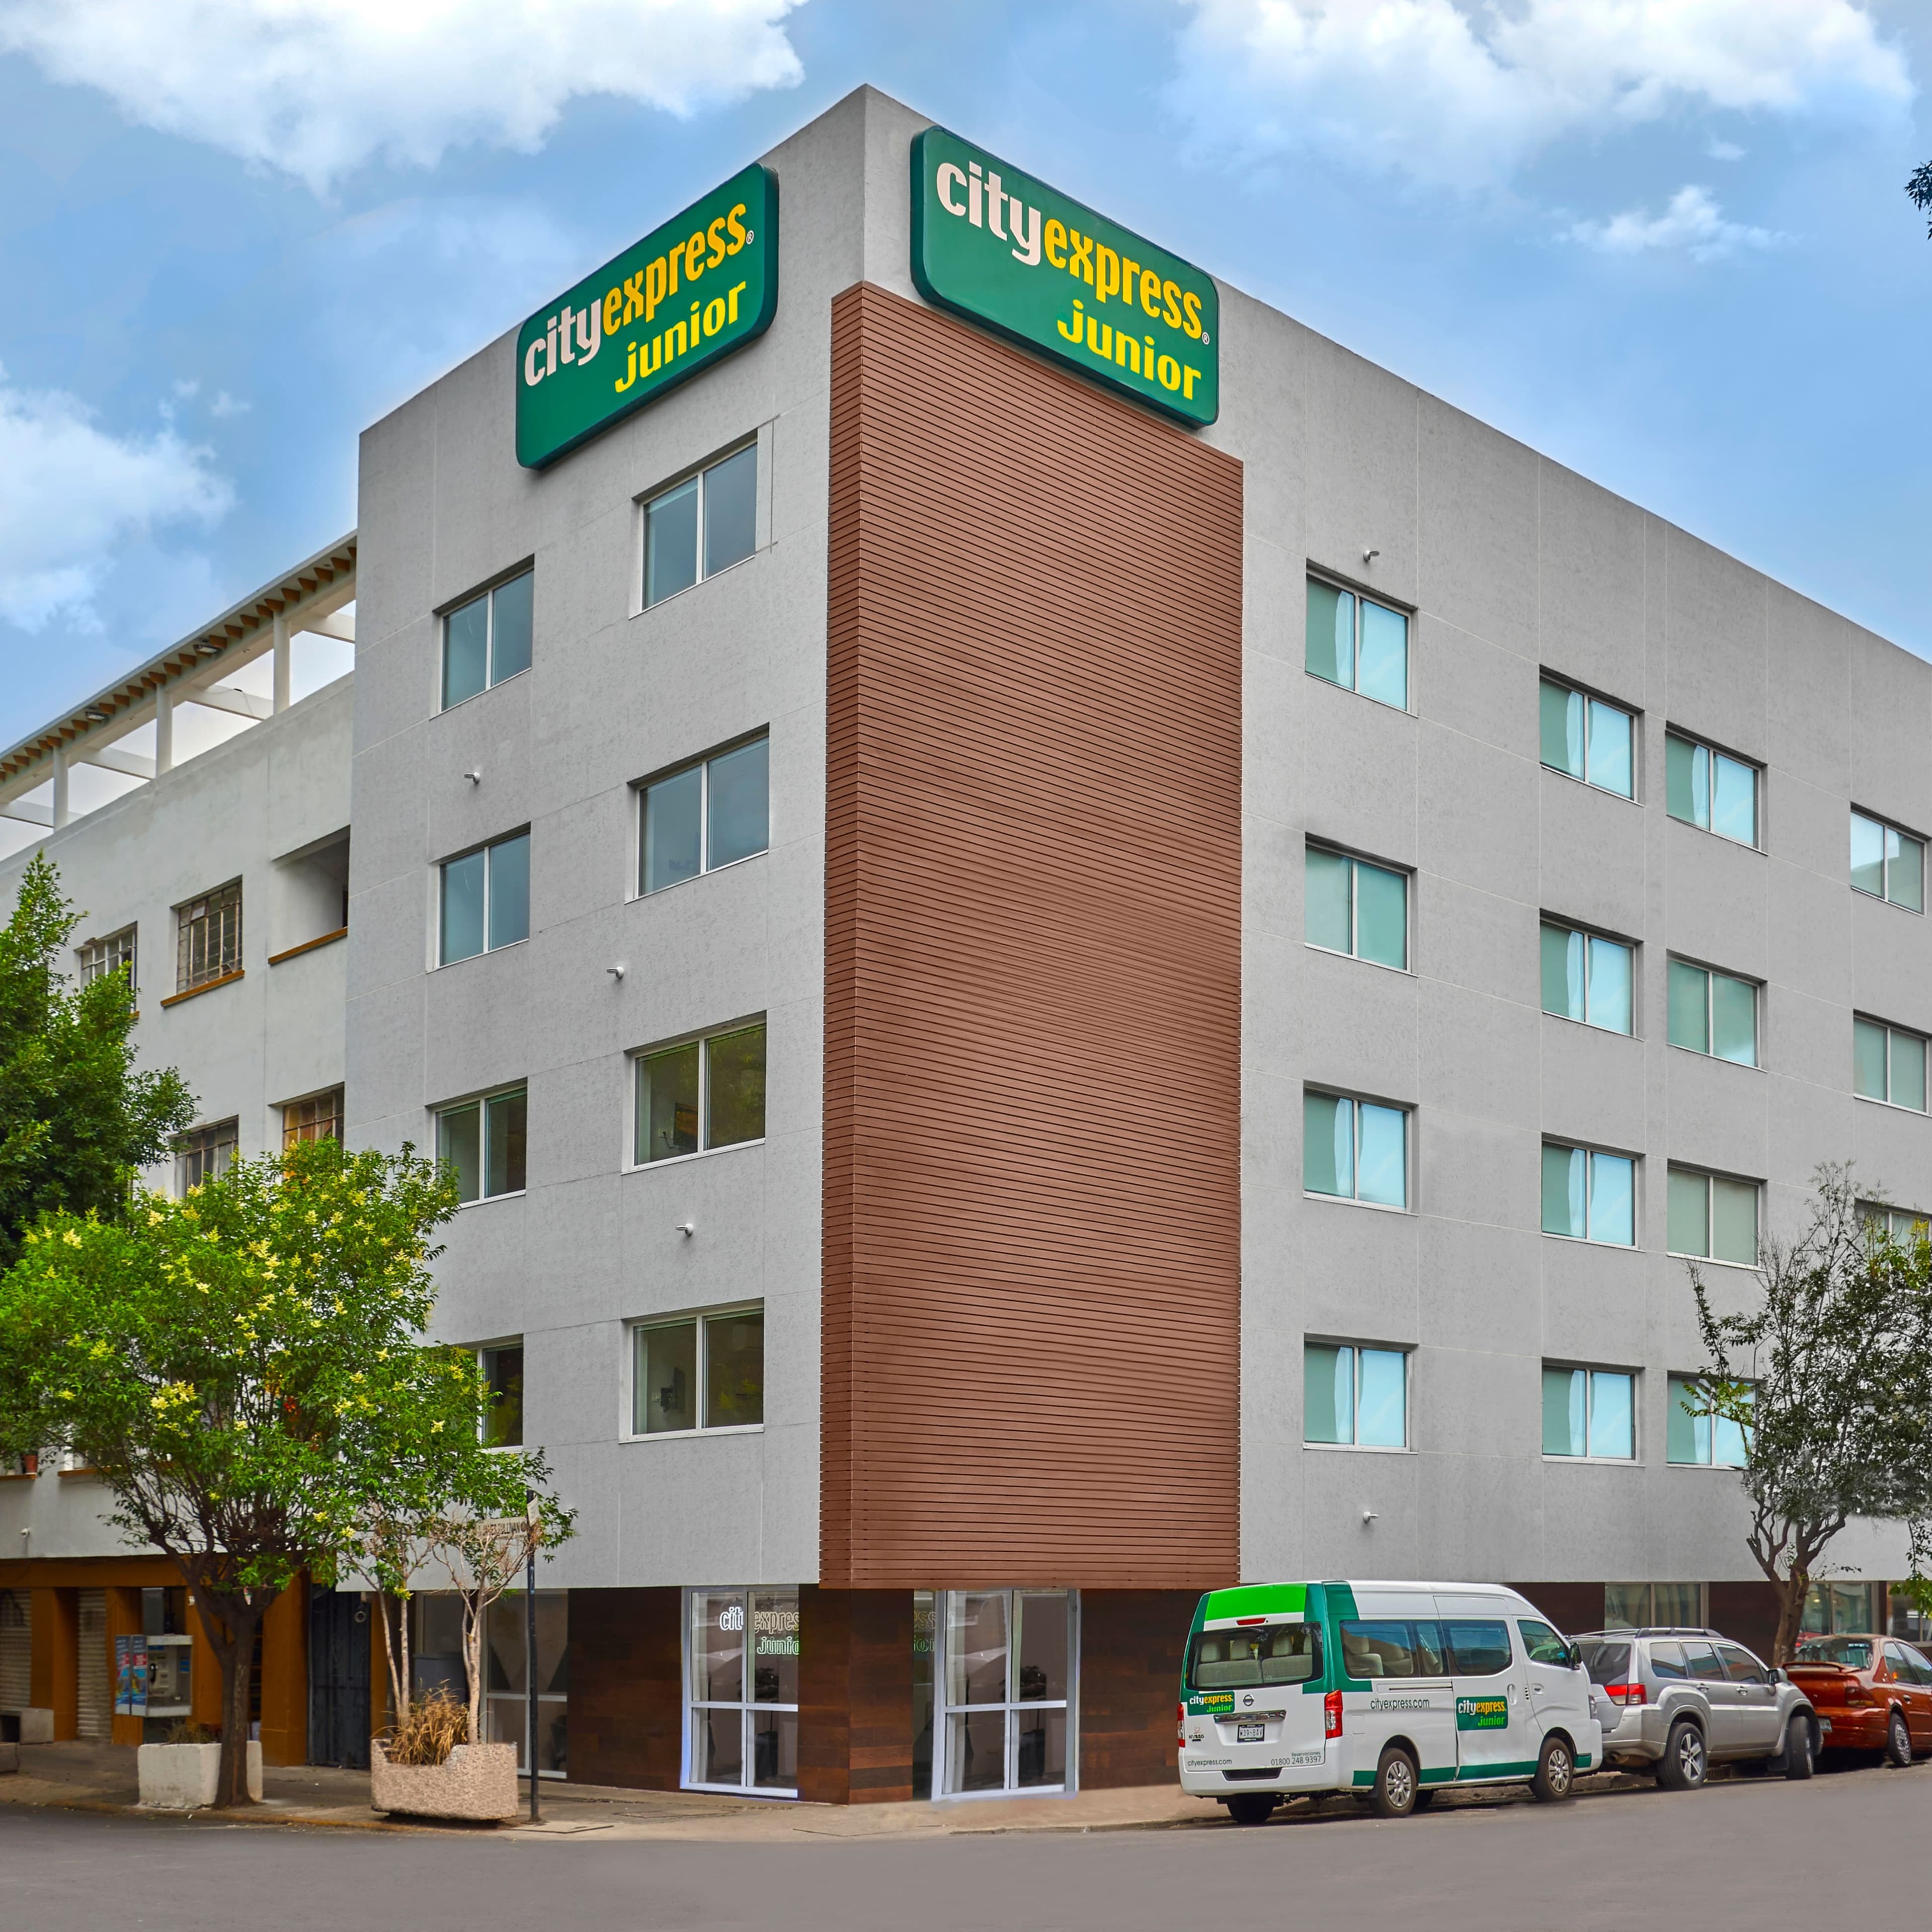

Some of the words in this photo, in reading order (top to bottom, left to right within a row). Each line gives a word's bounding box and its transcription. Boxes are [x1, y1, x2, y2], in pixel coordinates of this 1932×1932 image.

[615, 281, 746, 393] junior
[1057, 299, 1201, 400] junior
[1371, 1698, 1430, 1711] cityexpress.com
[1187, 1758, 1232, 1766] cityexpress.com
[1305, 1755, 1321, 1763] 9397
